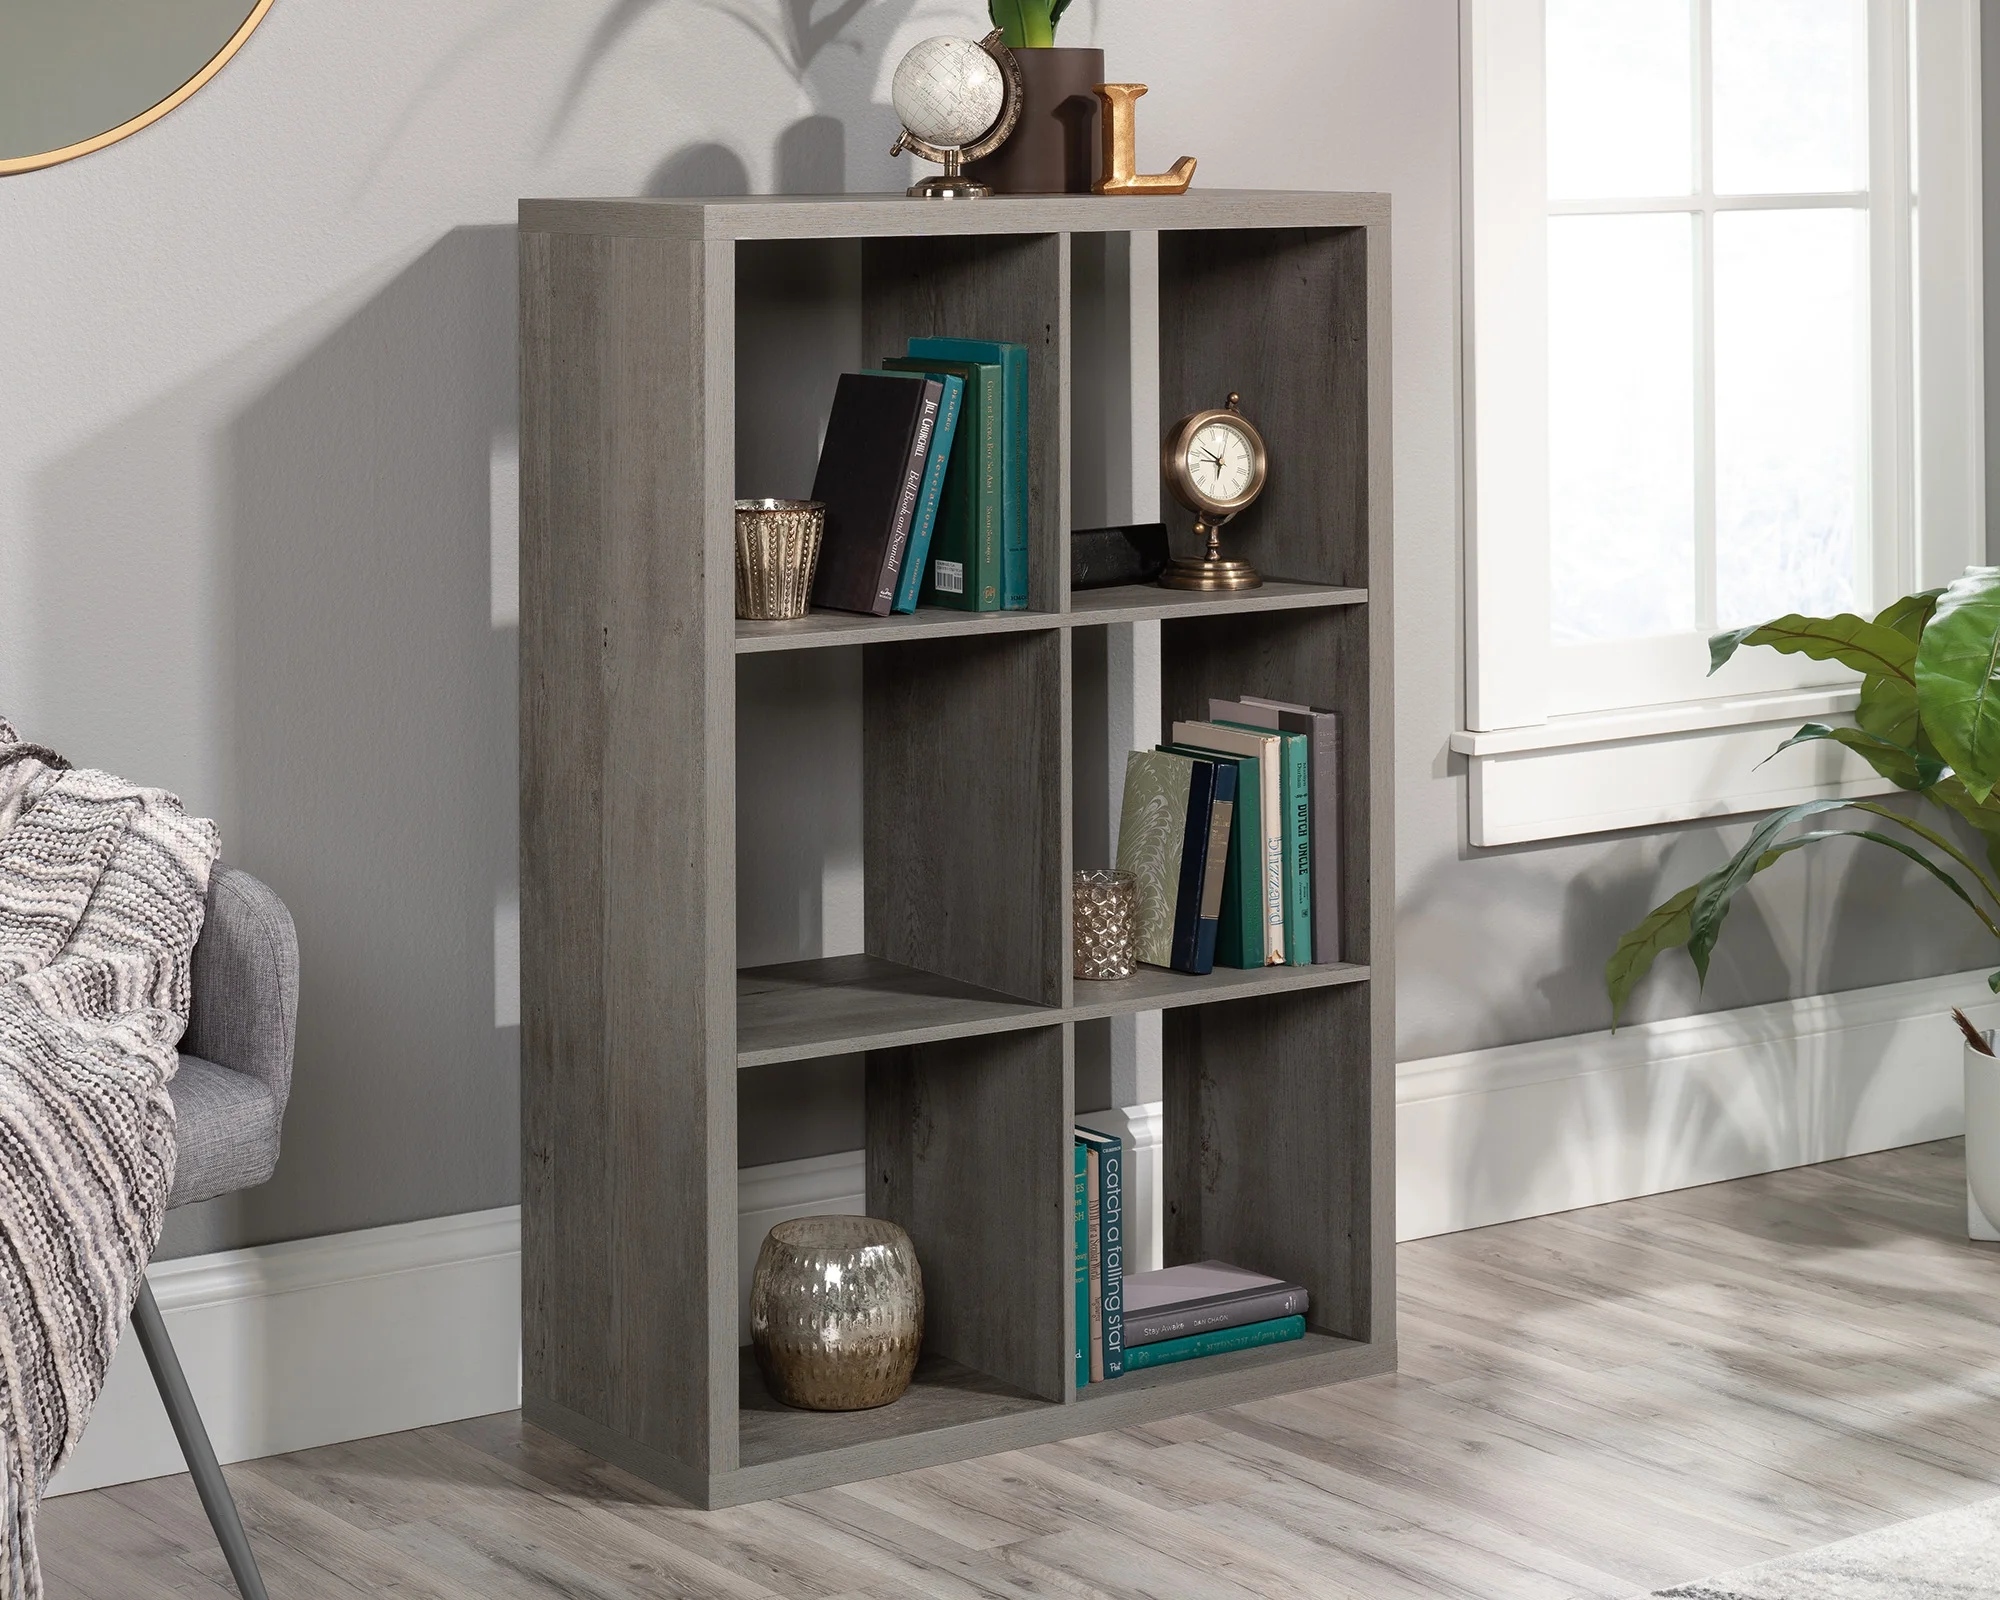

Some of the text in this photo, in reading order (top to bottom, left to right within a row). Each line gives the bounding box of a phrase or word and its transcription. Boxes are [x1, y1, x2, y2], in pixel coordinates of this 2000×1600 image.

[1091, 83, 1198, 195] L
[914, 398, 938, 457] JILL CHURCHILL
[886, 470, 920, 573] Bell, Book, and Scandal
[920, 453, 946, 538] Revelations
[1268, 837, 1284, 926] blizzard
[1297, 804, 1308, 876] DUTCH UNCLE
[1104, 1159, 1123, 1353] catch a falling star
[1144, 1322, 1184, 1338] Stay Awake
[1193, 1314, 1228, 1327] DAN CHAON
